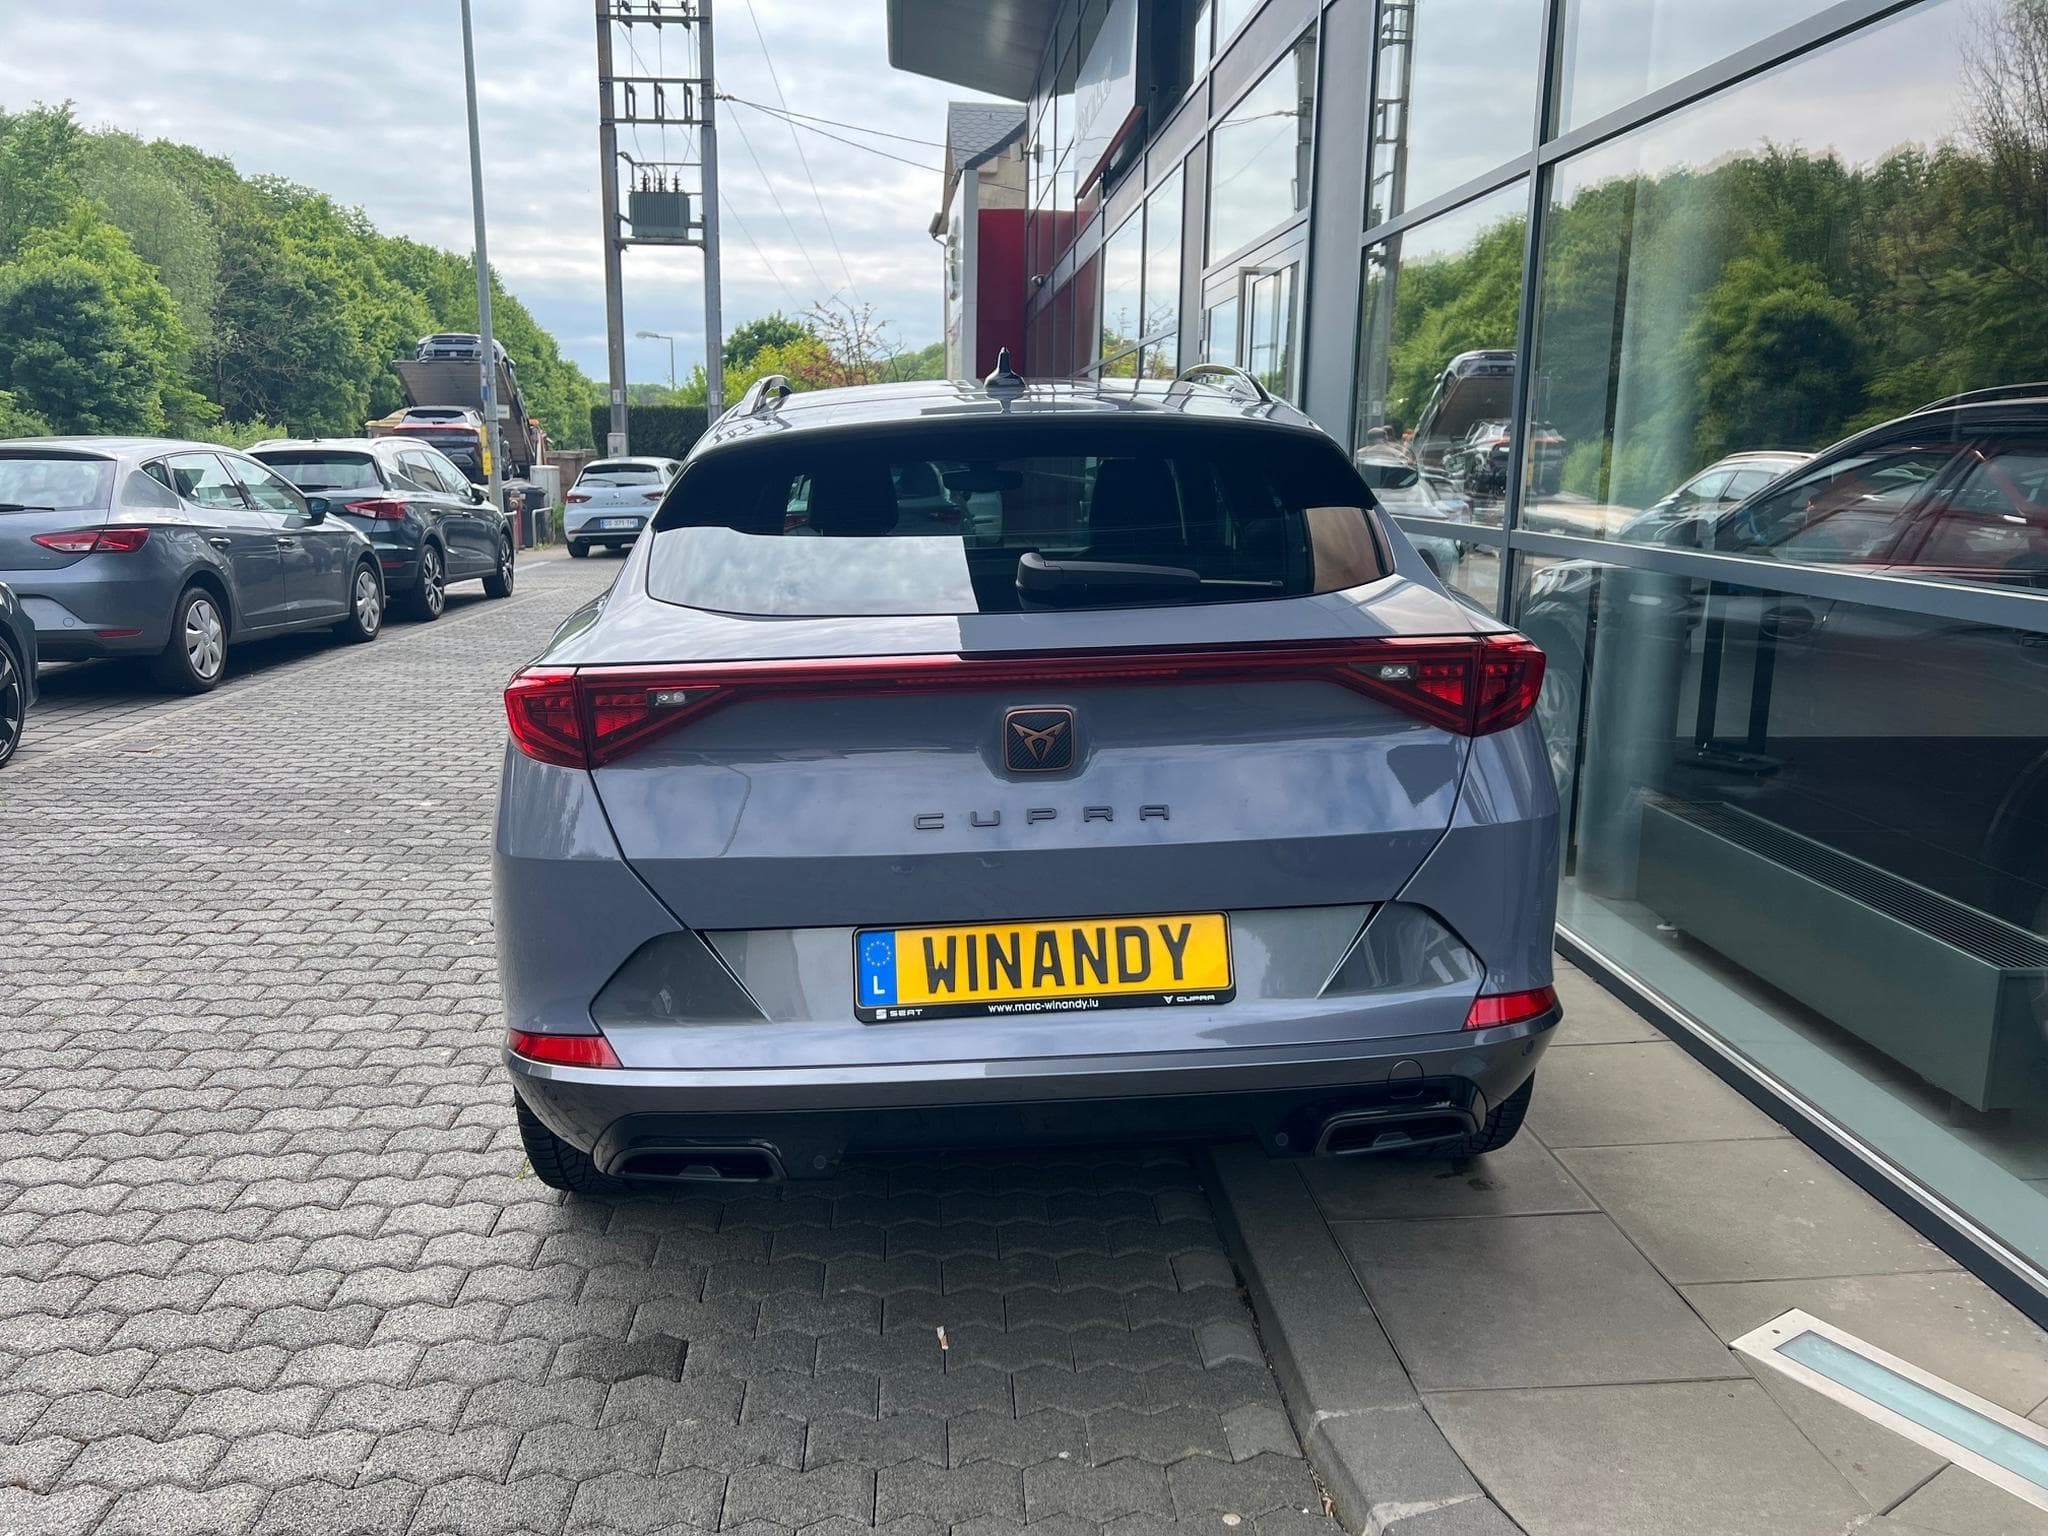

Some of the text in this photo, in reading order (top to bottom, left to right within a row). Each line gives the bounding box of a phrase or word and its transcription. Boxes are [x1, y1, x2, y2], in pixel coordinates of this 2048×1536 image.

[914, 805, 1170, 830] CUPRA
[923, 923, 1192, 993] WINANDY
[873, 975, 885, 994] L
[988, 998, 1098, 1013] www.marc-winandy.lu
[1176, 995, 1215, 1003] CUPRA
[889, 1009, 923, 1017] SEAT
